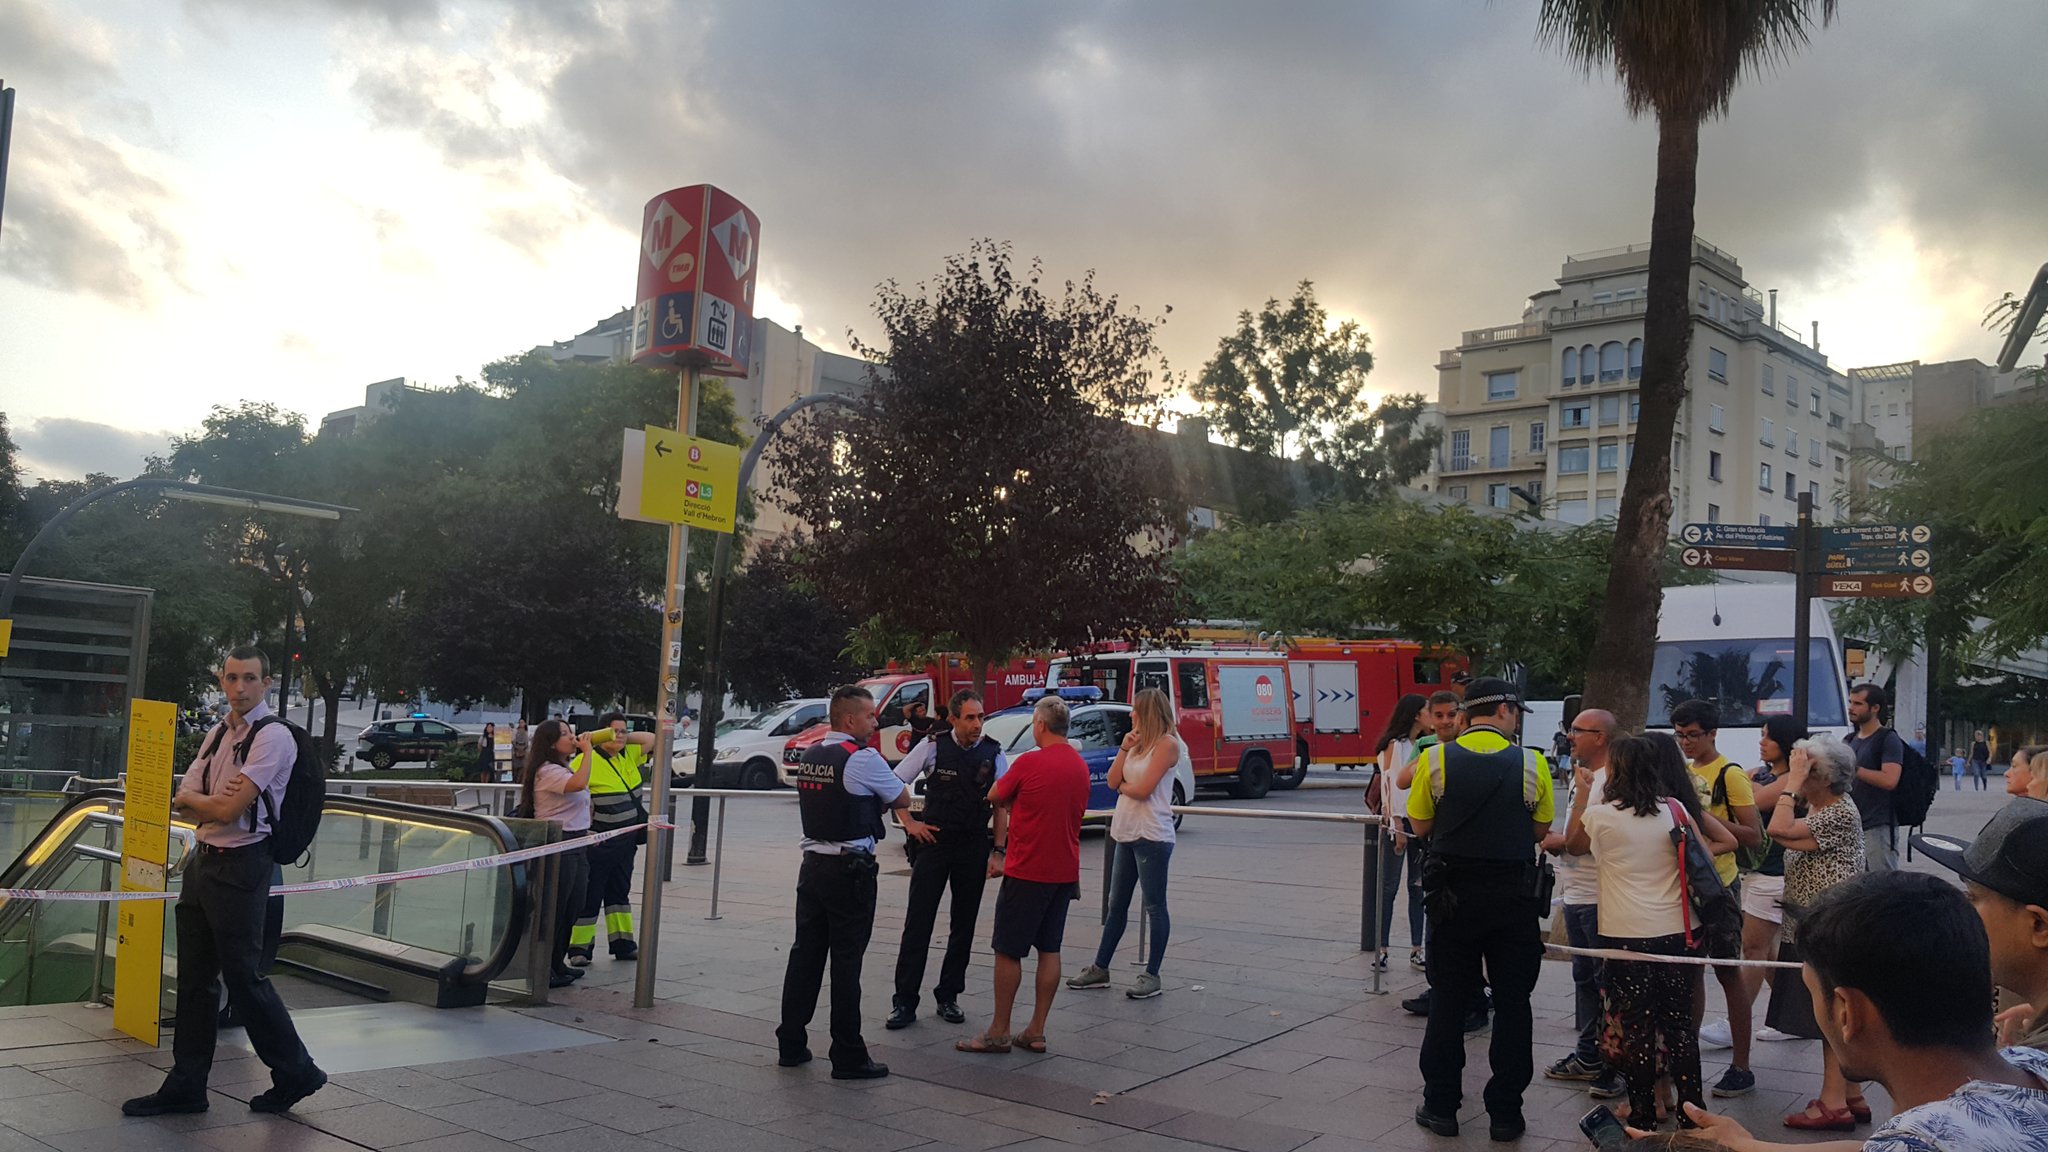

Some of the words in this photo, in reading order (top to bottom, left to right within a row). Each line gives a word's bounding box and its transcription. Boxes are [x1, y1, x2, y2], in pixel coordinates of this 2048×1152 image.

[652, 215, 673, 253] M
[729, 224, 748, 265] M
[672, 263, 690, 273] TMB
[691, 448, 699, 460] B
[701, 486, 712, 497] L3
[684, 499, 711, 511] Direcció
[683, 508, 696, 517] Vall
[697, 512, 726, 523] d'Hebron
[1004, 672, 1047, 686] AMBULÀ
[1256, 683, 1273, 696] 080
[798, 763, 834, 777] POLICIA
